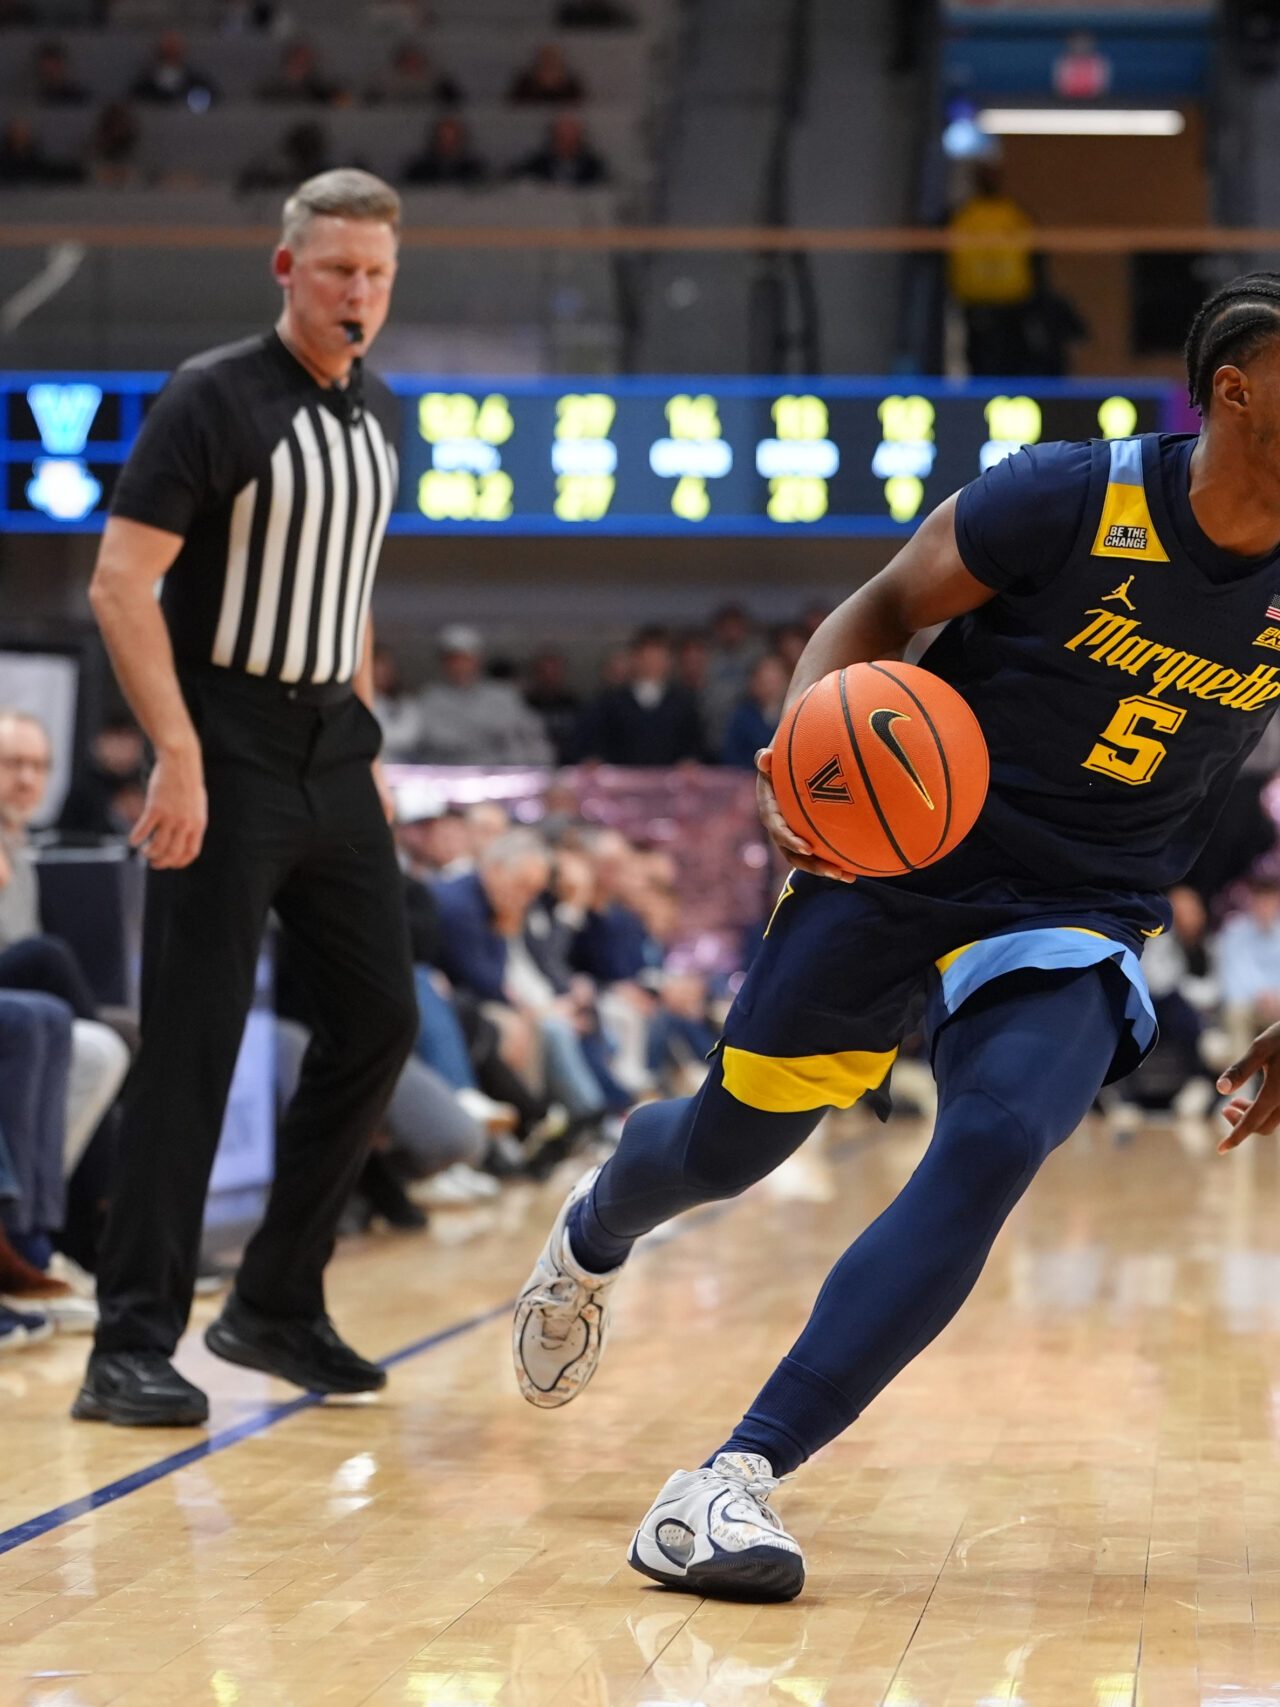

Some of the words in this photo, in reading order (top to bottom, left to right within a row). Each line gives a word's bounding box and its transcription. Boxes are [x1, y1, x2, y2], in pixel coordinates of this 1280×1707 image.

[1110, 526, 1125, 537] BE
[1127, 527, 1146, 539] THE
[1104, 536, 1146, 549] CHANGE
[1081, 694, 1188, 786] 5
